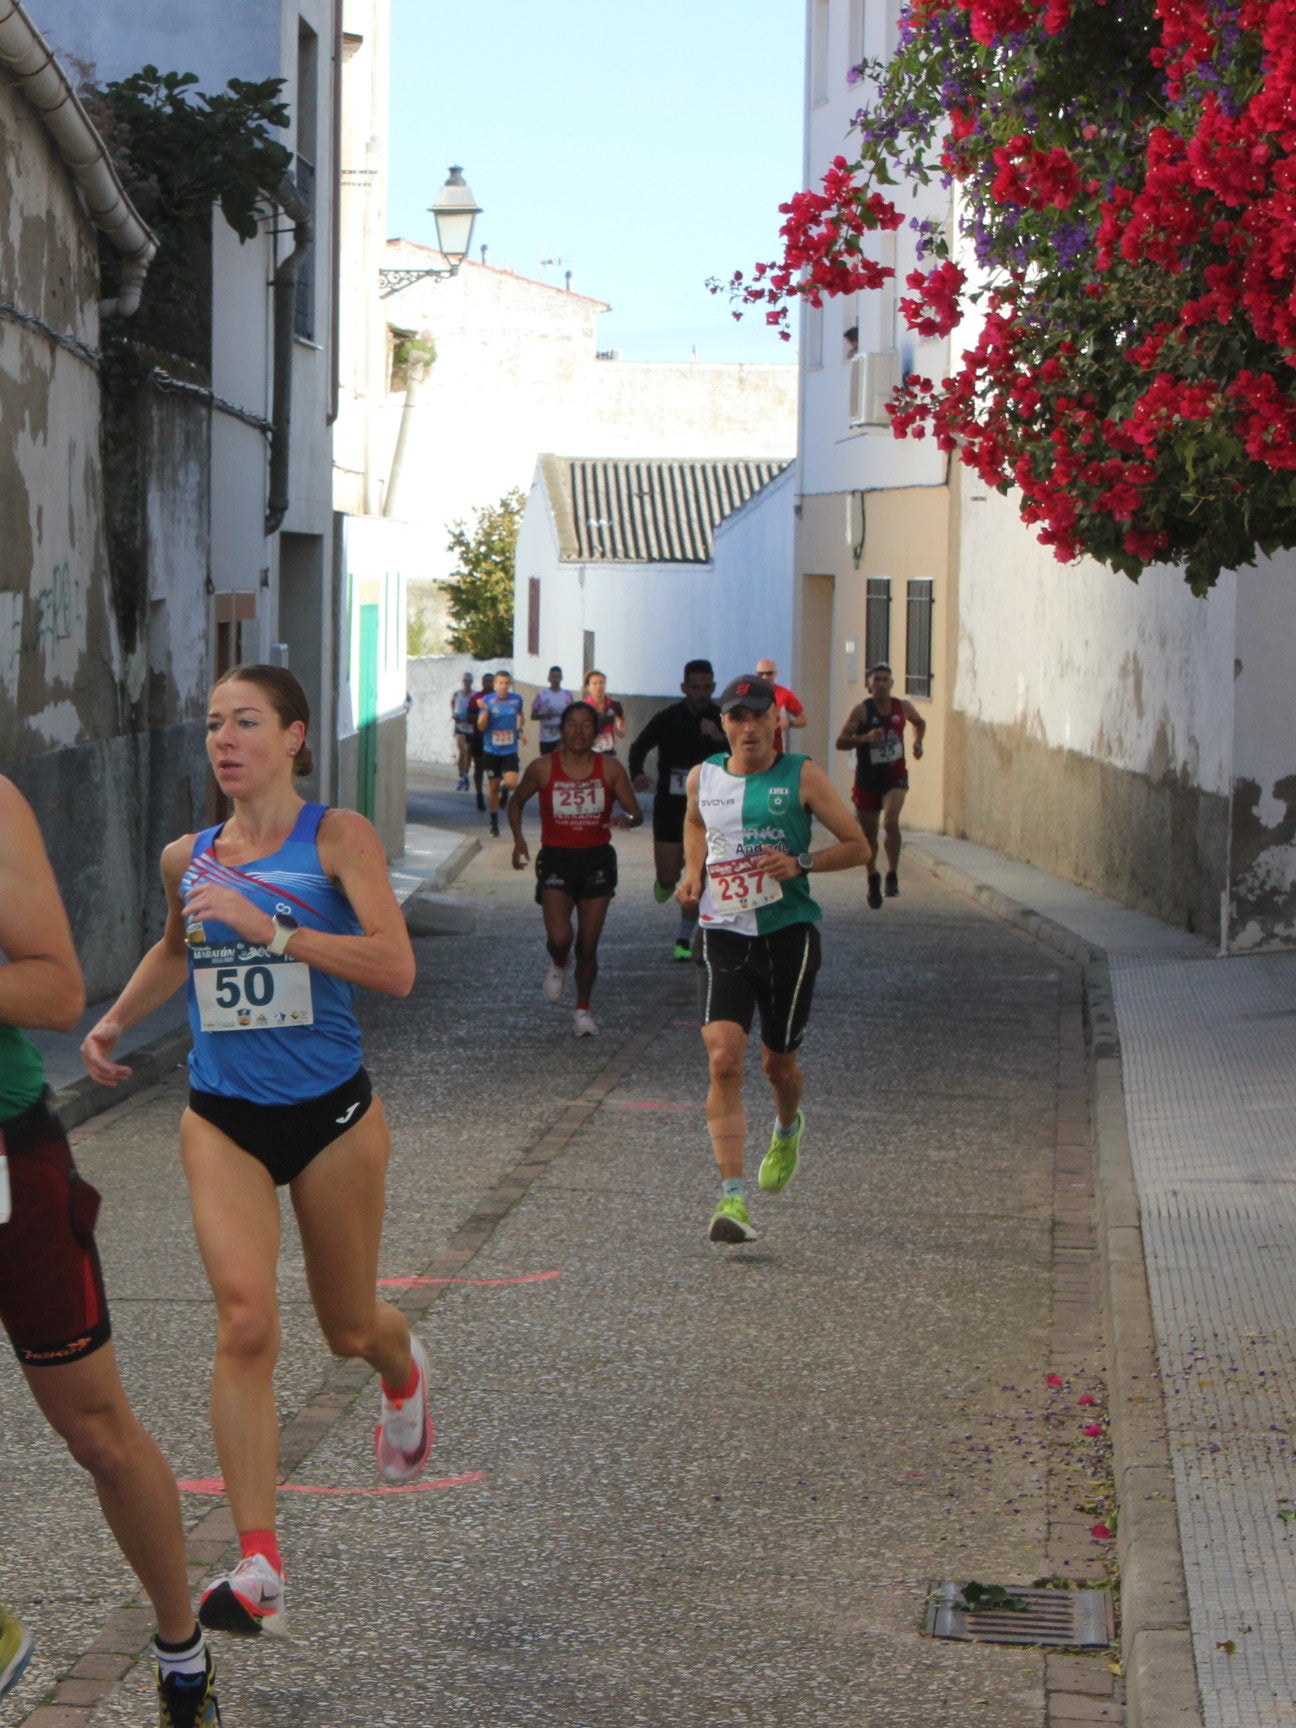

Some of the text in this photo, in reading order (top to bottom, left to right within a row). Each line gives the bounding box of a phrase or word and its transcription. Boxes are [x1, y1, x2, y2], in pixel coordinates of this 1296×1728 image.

[559, 788, 596, 807] 251
[735, 841, 791, 855] Andade
[717, 870, 767, 902] 237
[215, 966, 275, 1010] 50
